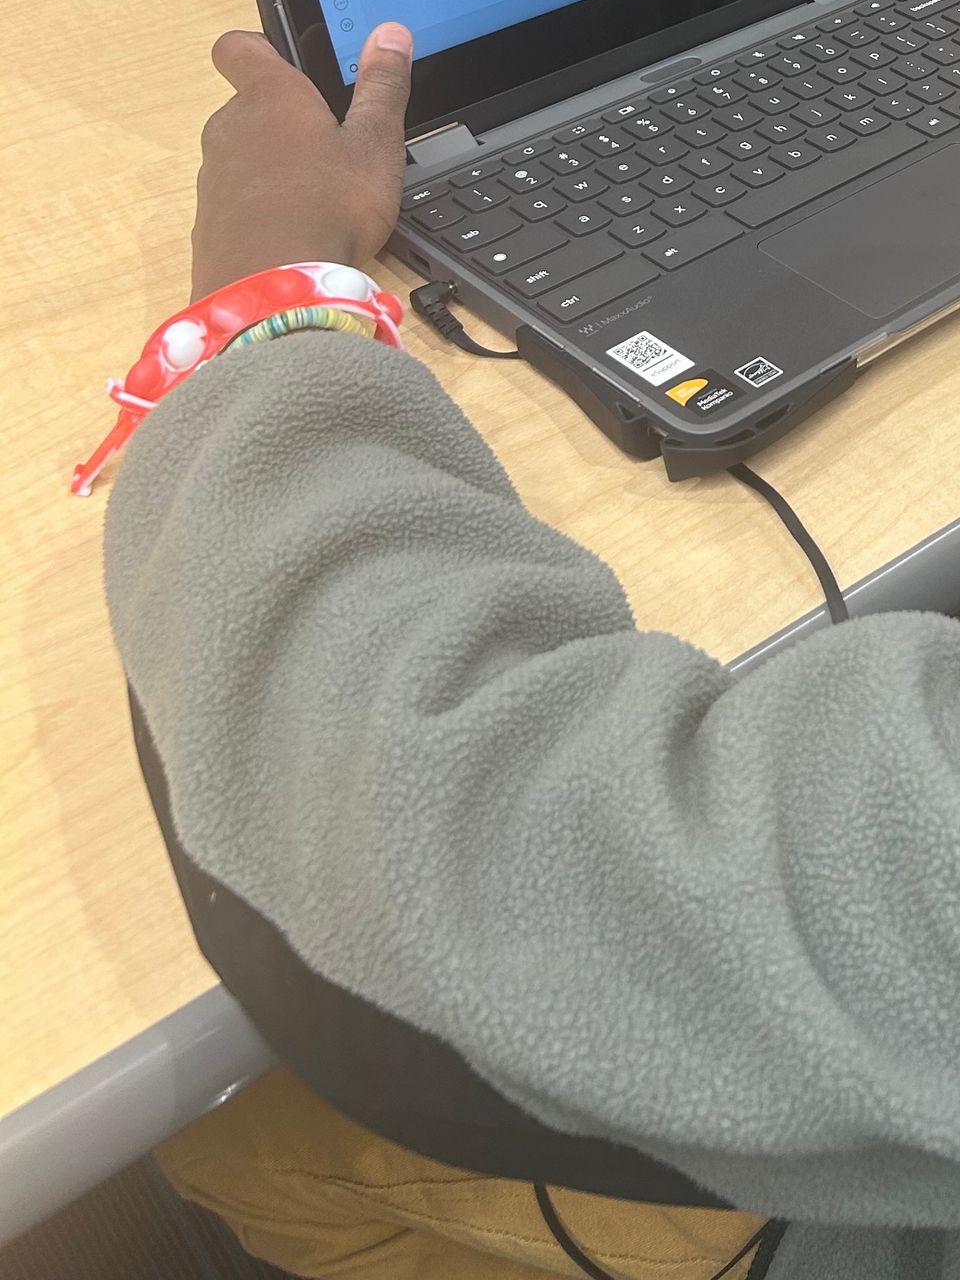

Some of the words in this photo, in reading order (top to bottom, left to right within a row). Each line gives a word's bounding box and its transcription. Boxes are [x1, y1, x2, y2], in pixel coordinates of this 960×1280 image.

[868, 52, 880, 61] p
[803, 81, 813, 89] i
[769, 97, 781, 105] u
[843, 93, 857, 101] k
[732, 112, 744, 121] y
[810, 109, 823, 118] j
[859, 117, 874, 126] m
[928, 117, 941, 127] alt
[773, 125, 788, 133] h
[658, 146, 666, 154] r
[739, 141, 753, 150] g
[701, 158, 711, 166] f
[525, 177, 538, 185] 2
[662, 175, 674, 184] d
[573, 180, 588, 190] w
[412, 189, 431, 200] esc
[715, 186, 726, 194] c
[533, 200, 548, 209] q
[673, 205, 687, 214] x
[578, 215, 591, 223] a
[632, 225, 645, 234] z
[461, 230, 480, 240] tab
[664, 248, 679, 257] alt
[525, 270, 550, 284] shift
[560, 295, 580, 308] ctrl
[650, 358, 682, 377] eSupport
[696, 387, 729, 407] MediaTek
[700, 391, 734, 411] Kompanio
